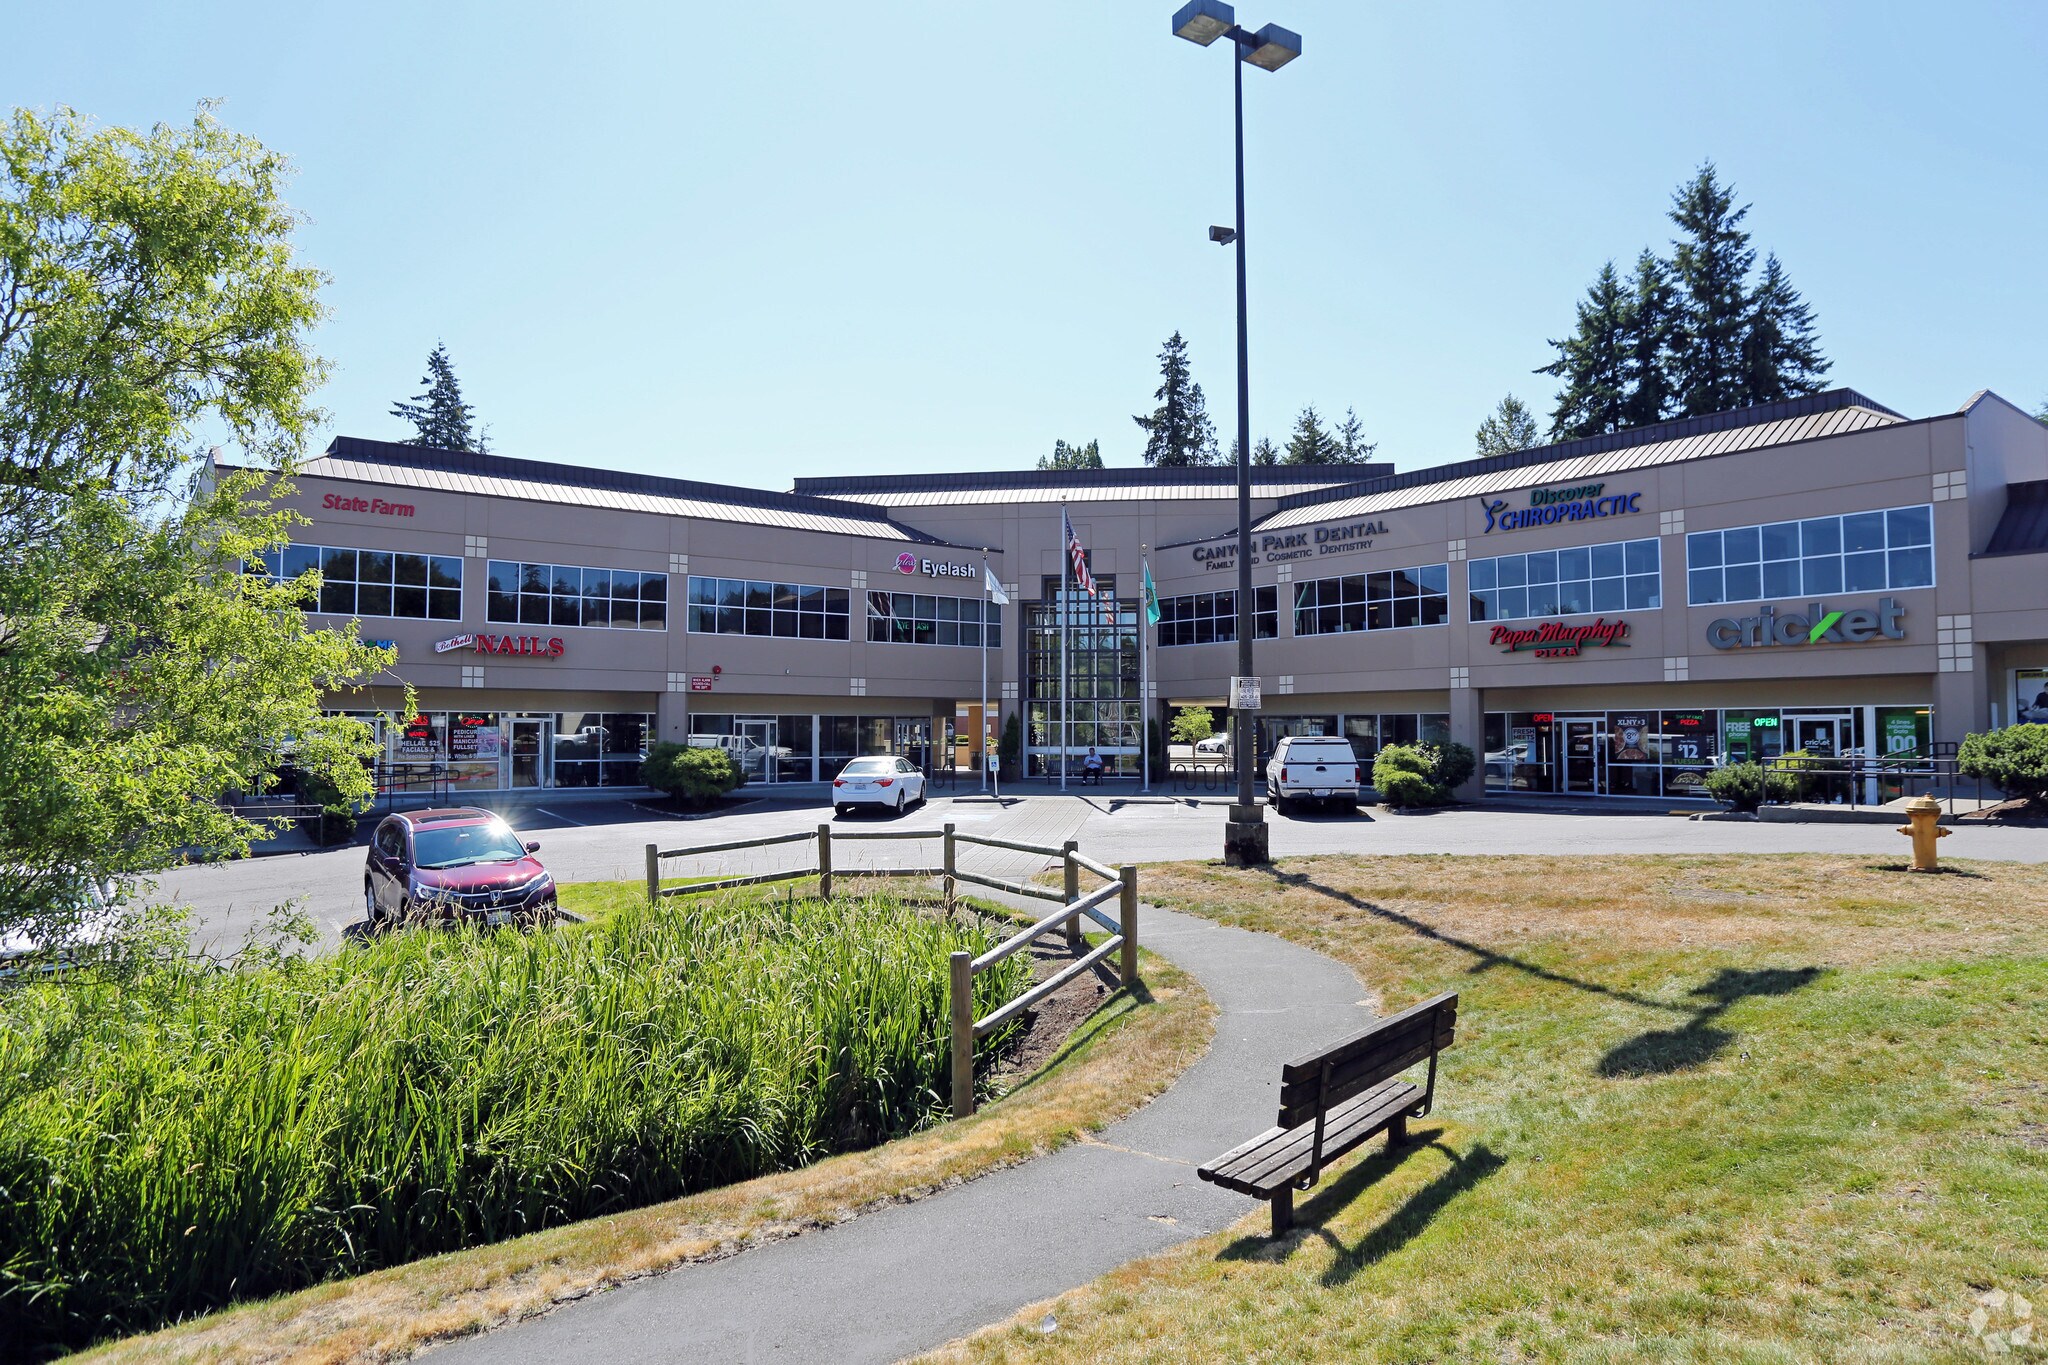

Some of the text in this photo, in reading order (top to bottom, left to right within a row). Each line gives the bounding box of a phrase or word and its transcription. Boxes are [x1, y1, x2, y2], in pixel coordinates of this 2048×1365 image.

[322, 494, 415, 517] State Farm
[1530, 483, 1605, 506] Discover
[1499, 492, 1641, 531] CHIROPRACTIC
[1262, 533, 1307, 551] PARK
[1314, 521, 1389, 543] DENTAL
[1206, 560, 1235, 570] FAMILY
[1266, 549, 1312, 562] COSMETIC
[1320, 540, 1373, 554] DENTISTRY
[922, 559, 976, 578] Eyelash
[1707, 597, 1904, 649] cricket
[438, 634, 565, 657] Bothell NAILS
[1490, 618, 1628, 652] Papa Murphy's
[1535, 647, 1578, 657] PIZZA
[1533, 714, 1552, 722] OPEN
[1726, 722, 1751, 732] FREE
[1754, 717, 1778, 727] OPEN
[1678, 744, 1699, 758] $12
